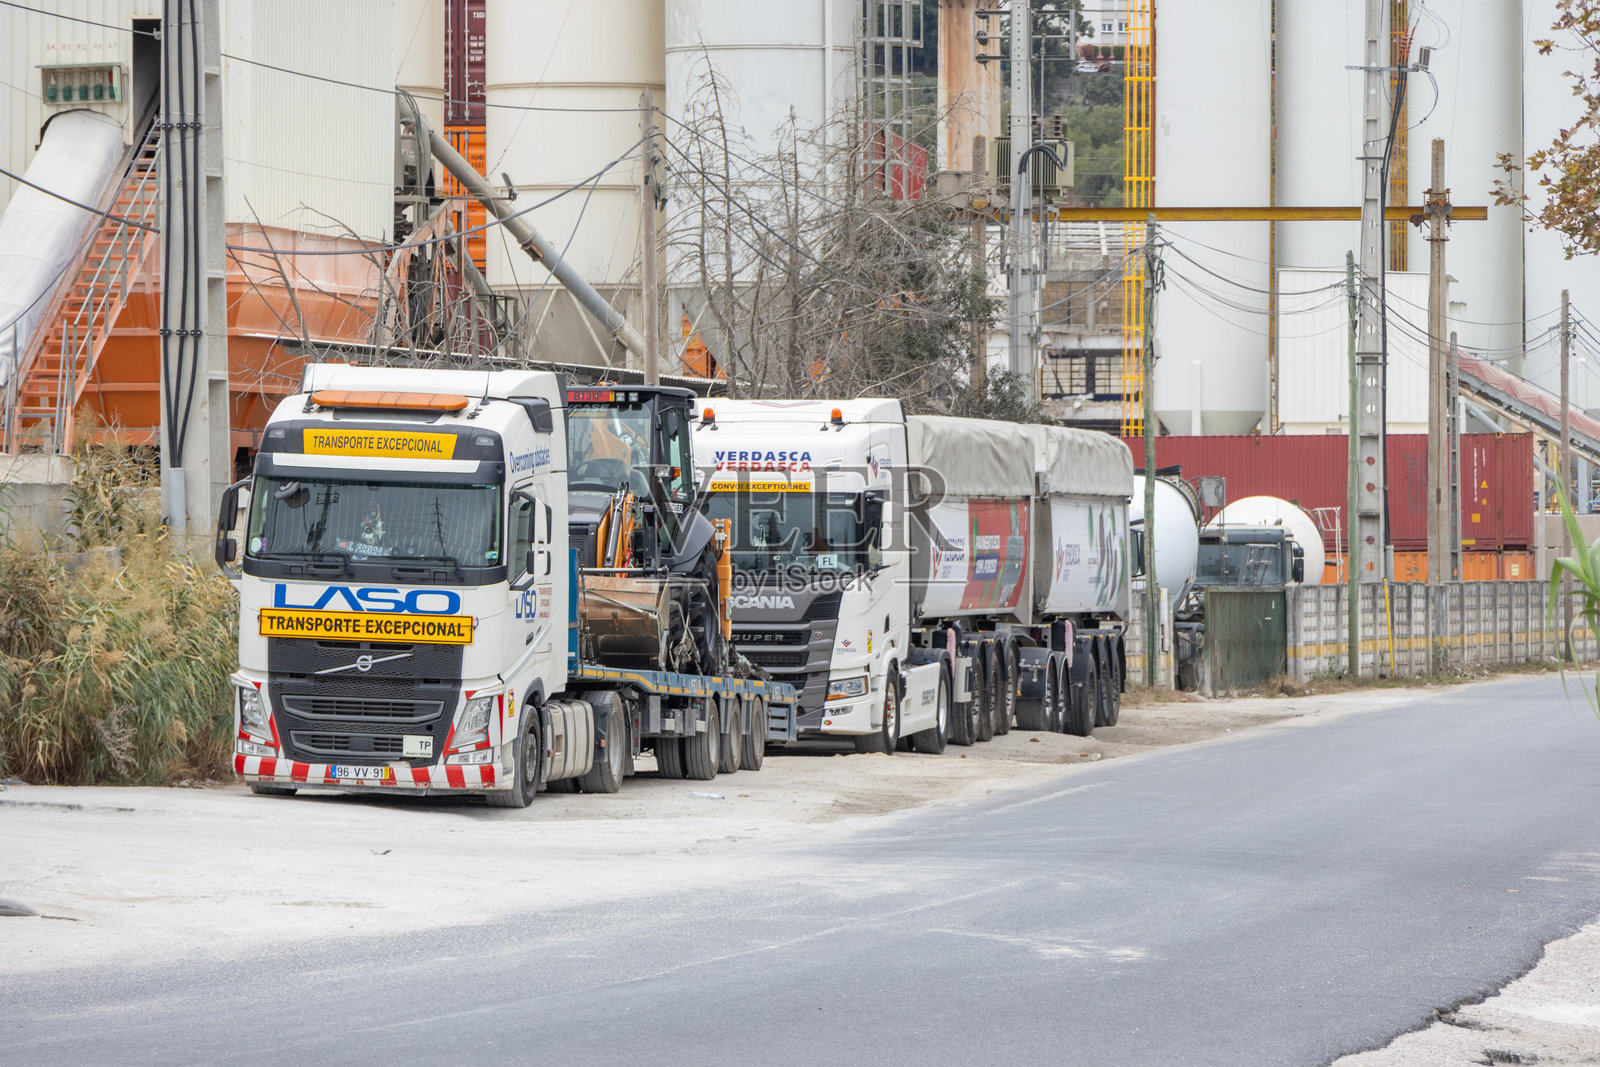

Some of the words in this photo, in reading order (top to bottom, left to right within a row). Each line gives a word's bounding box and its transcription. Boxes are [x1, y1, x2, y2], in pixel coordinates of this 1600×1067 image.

[313, 435, 374, 449] TRANSPORTE
[377, 437, 443, 453] EXCEPCIONAL
[715, 451, 812, 461] VERDASCA
[715, 461, 811, 472] VERDASCA
[822, 557, 834, 567] FL
[274, 583, 461, 615] LASO
[515, 589, 537, 619] LASO
[727, 595, 795, 609] SCANIA
[267, 616, 361, 633] TRANSPORTE
[365, 619, 465, 637] EXCEPCIONAL
[419, 741, 431, 750] TP
